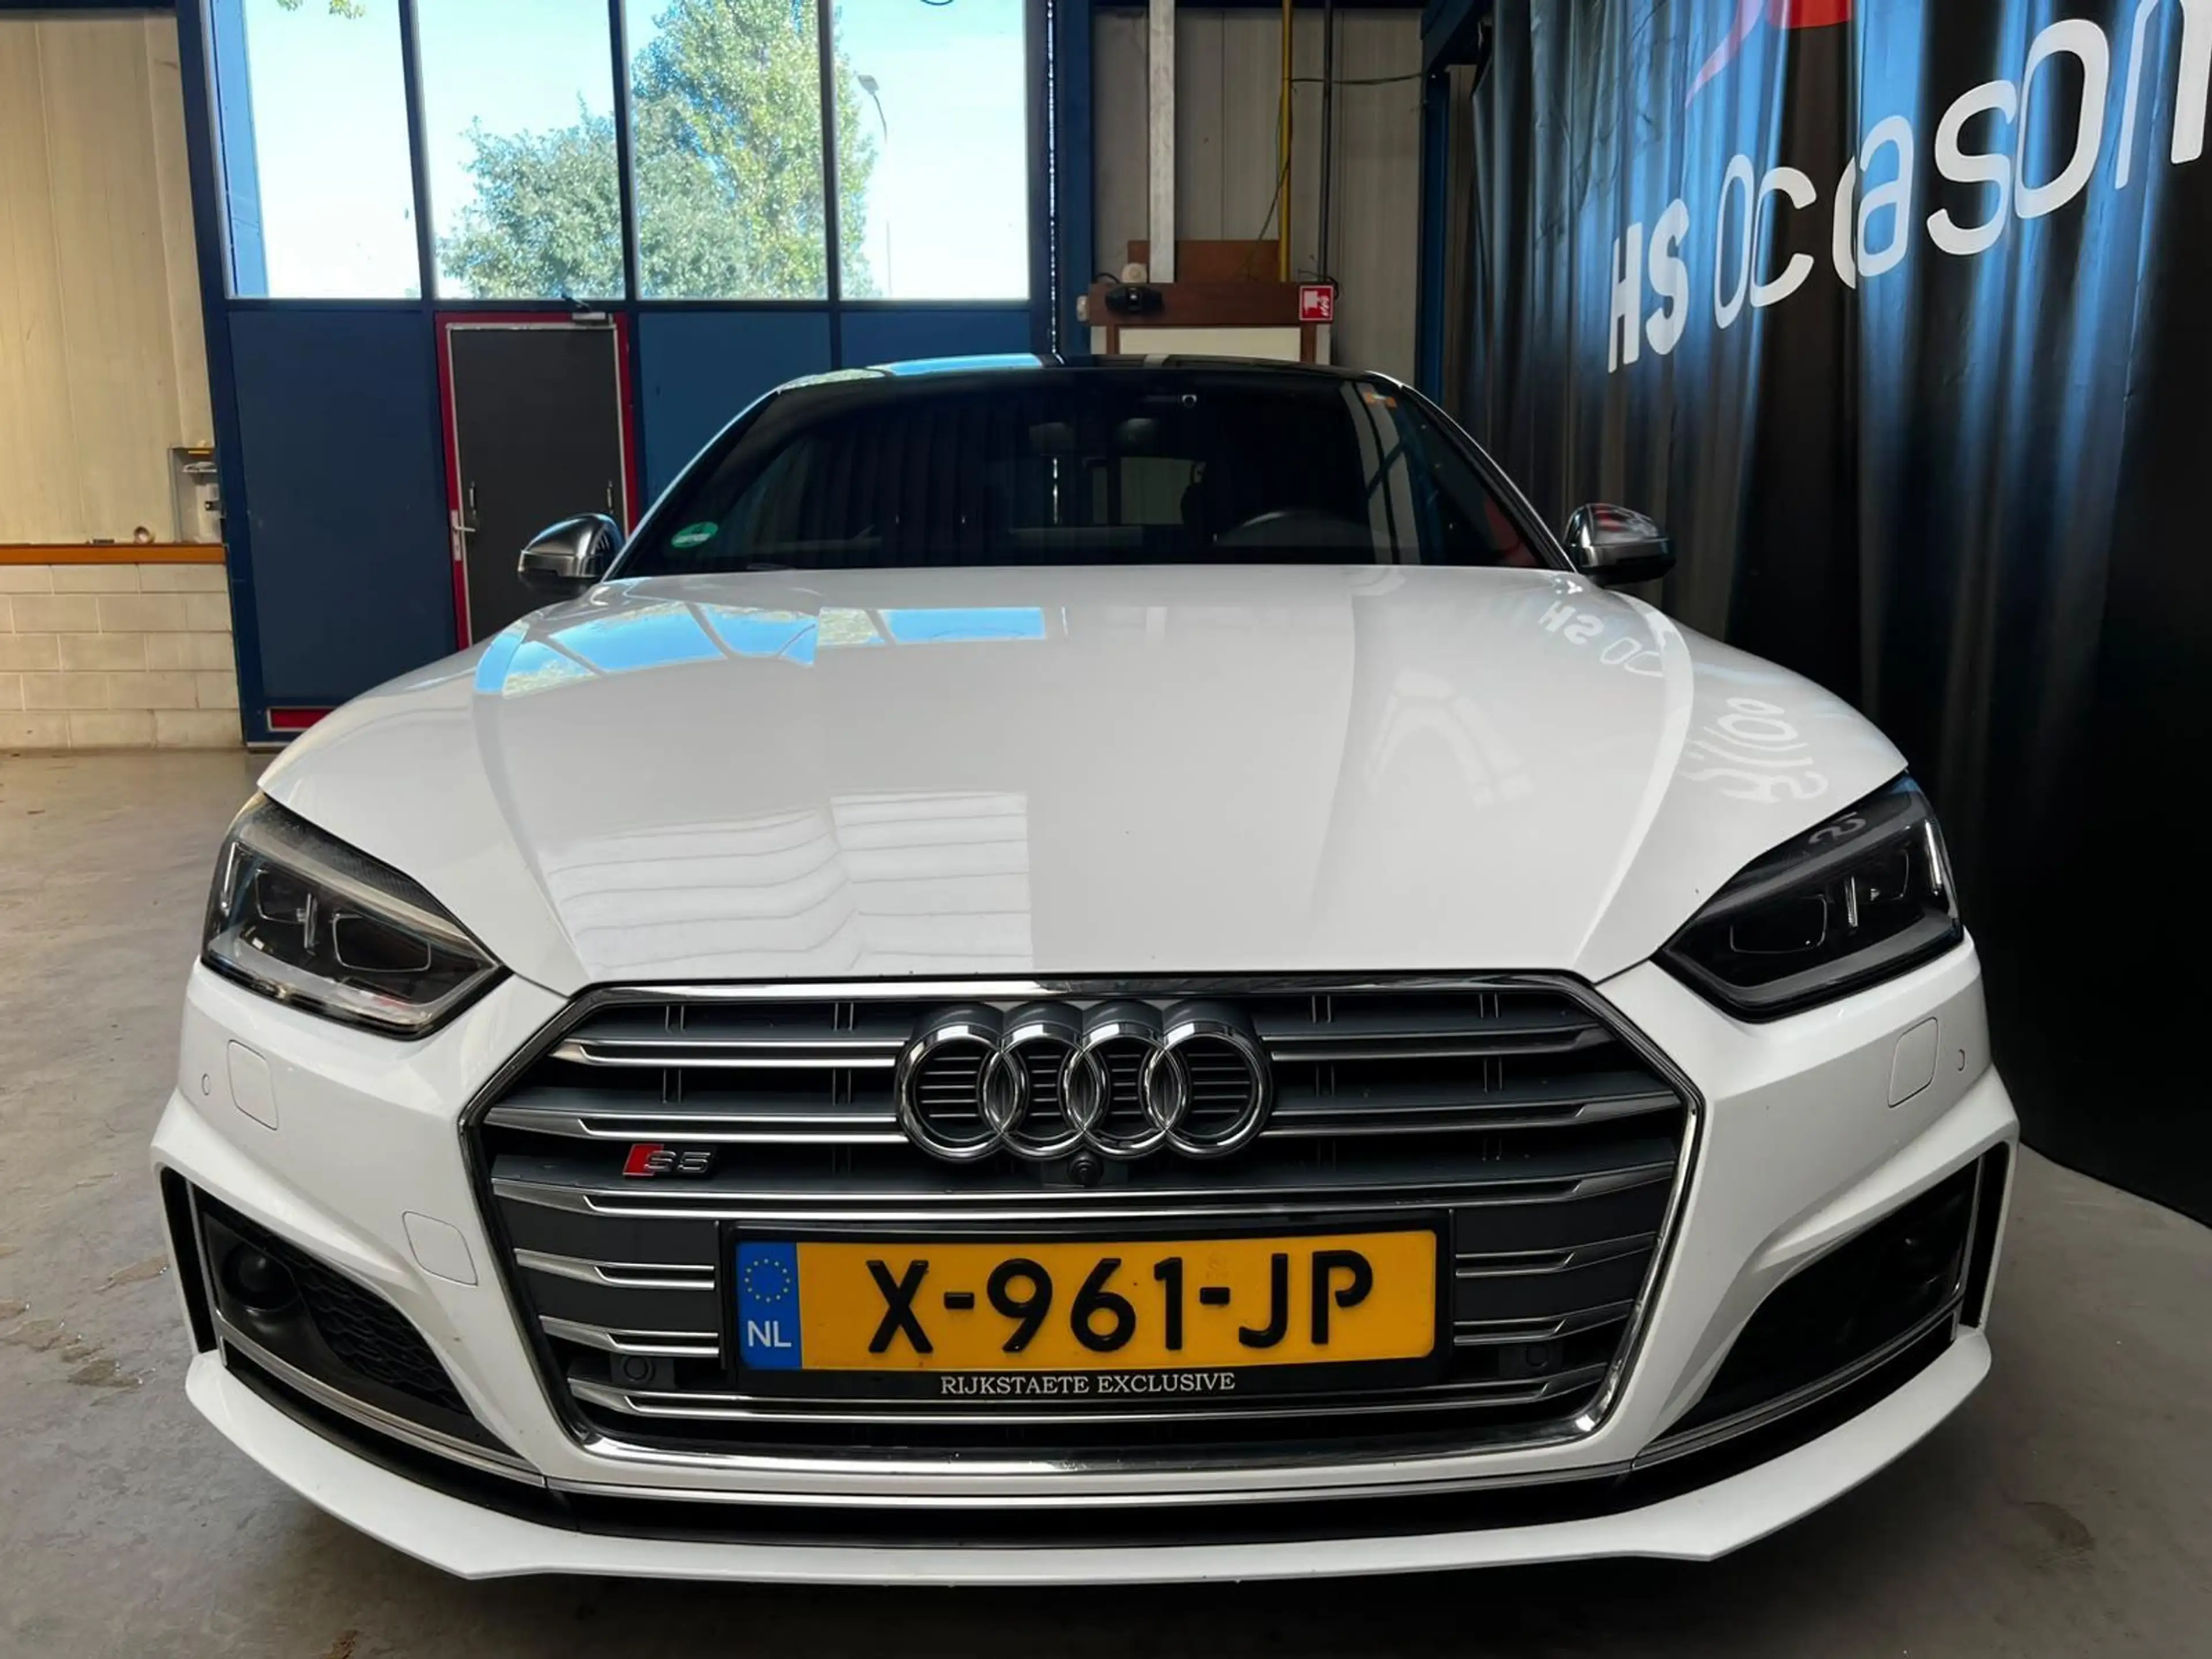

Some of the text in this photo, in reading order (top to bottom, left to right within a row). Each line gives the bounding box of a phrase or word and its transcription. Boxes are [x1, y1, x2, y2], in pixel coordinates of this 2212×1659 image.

[1608, 198, 1690, 373] HS
[642, 1150, 712, 1174] S5
[866, 1249, 1373, 1354] X-961-JP
[747, 1320, 792, 1348] NL
[940, 1372, 1236, 1395] RIJKSTAETE EXCLUSIVE
